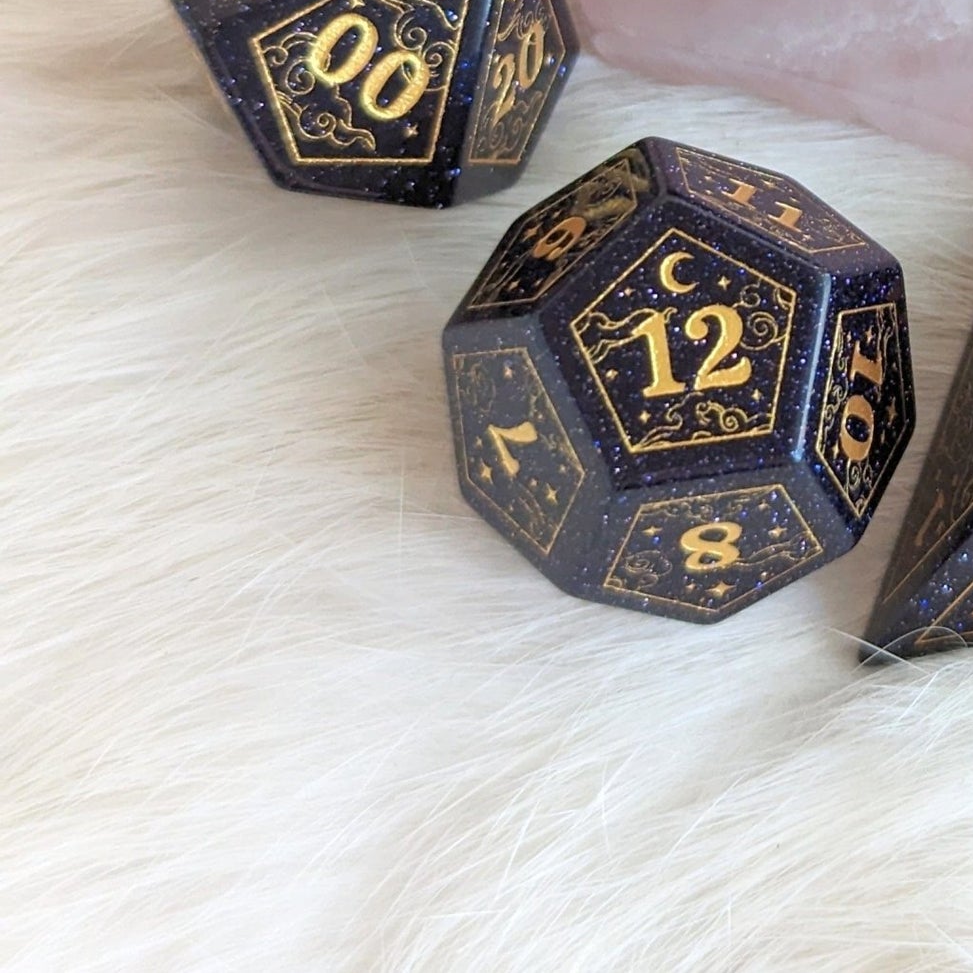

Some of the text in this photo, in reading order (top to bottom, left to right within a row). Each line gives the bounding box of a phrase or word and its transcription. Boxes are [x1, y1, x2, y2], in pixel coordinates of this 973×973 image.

[309, 12, 431, 121] 00
[492, 21, 545, 125] 20
[728, 179, 804, 232] 11
[633, 304, 752, 399] 12
[839, 342, 884, 462] 10
[487, 422, 539, 478] 7
[678, 520, 744, 573] 8
